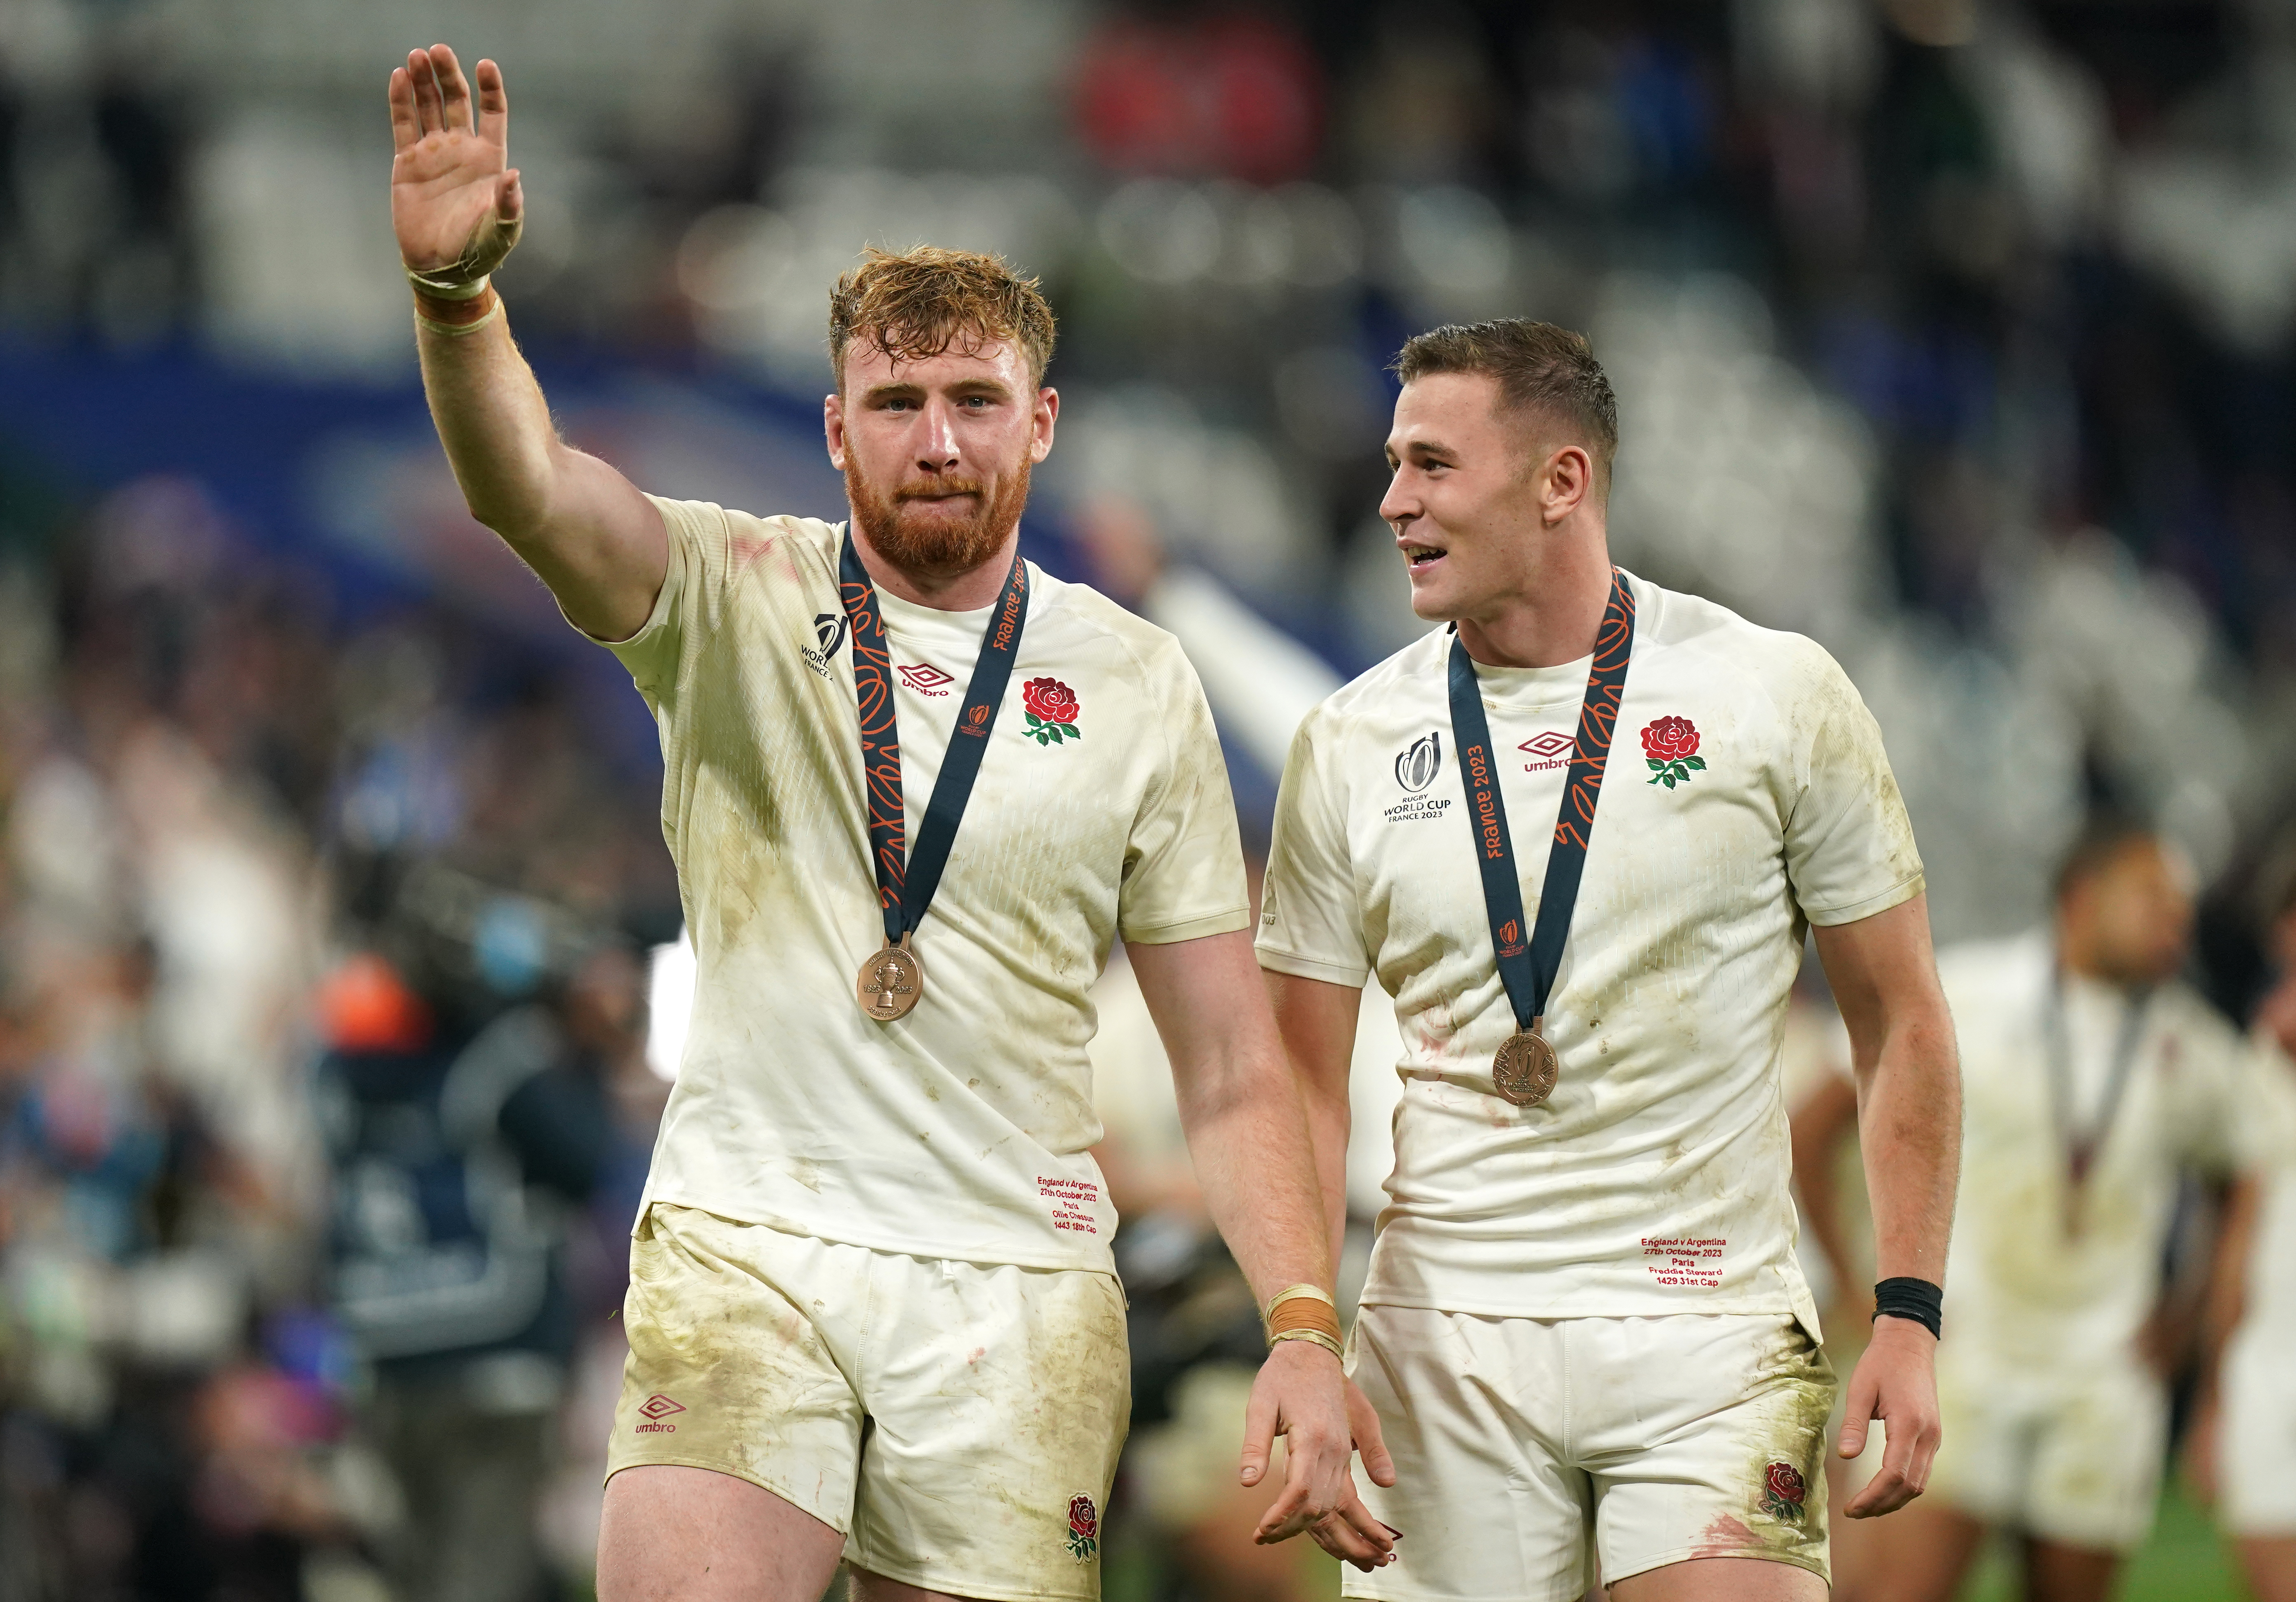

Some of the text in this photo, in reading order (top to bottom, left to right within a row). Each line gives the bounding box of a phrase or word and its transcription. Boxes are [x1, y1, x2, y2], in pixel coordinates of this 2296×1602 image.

[1012, 555, 1024, 593] 2023
[801, 644, 828, 669] WORL
[805, 659, 829, 678] FRANCE
[902, 678, 948, 696] umbro
[1468, 745, 1488, 787] 2023
[1403, 793, 1428, 803] RUGBY
[1385, 800, 1451, 816] WORLD CUP
[1389, 813, 1419, 823] FRANCE
[868, 950, 913, 967] RUGBY WORLD CUP
[863, 985, 881, 993] 1823
[888, 1007, 902, 1016] 2023
[1038, 1177, 1064, 1187] England
[1071, 1180, 1098, 1191] Argentina
[1040, 1188, 1096, 1202] 27th October 2023
[1063, 1201, 1079, 1209] Paris
[1069, 1211, 1095, 1222] Chessum
[1072, 1223, 1085, 1231] 18th
[1086, 1224, 1097, 1234] Cap
[1641, 1238, 1678, 1247] England
[1686, 1238, 1726, 1247] Argentina
[1672, 1258, 1695, 1266] Paris
[1680, 1277, 1698, 1285] 31st
[1701, 1278, 1719, 1288] Cap
[635, 1421, 676, 1433] umbro
